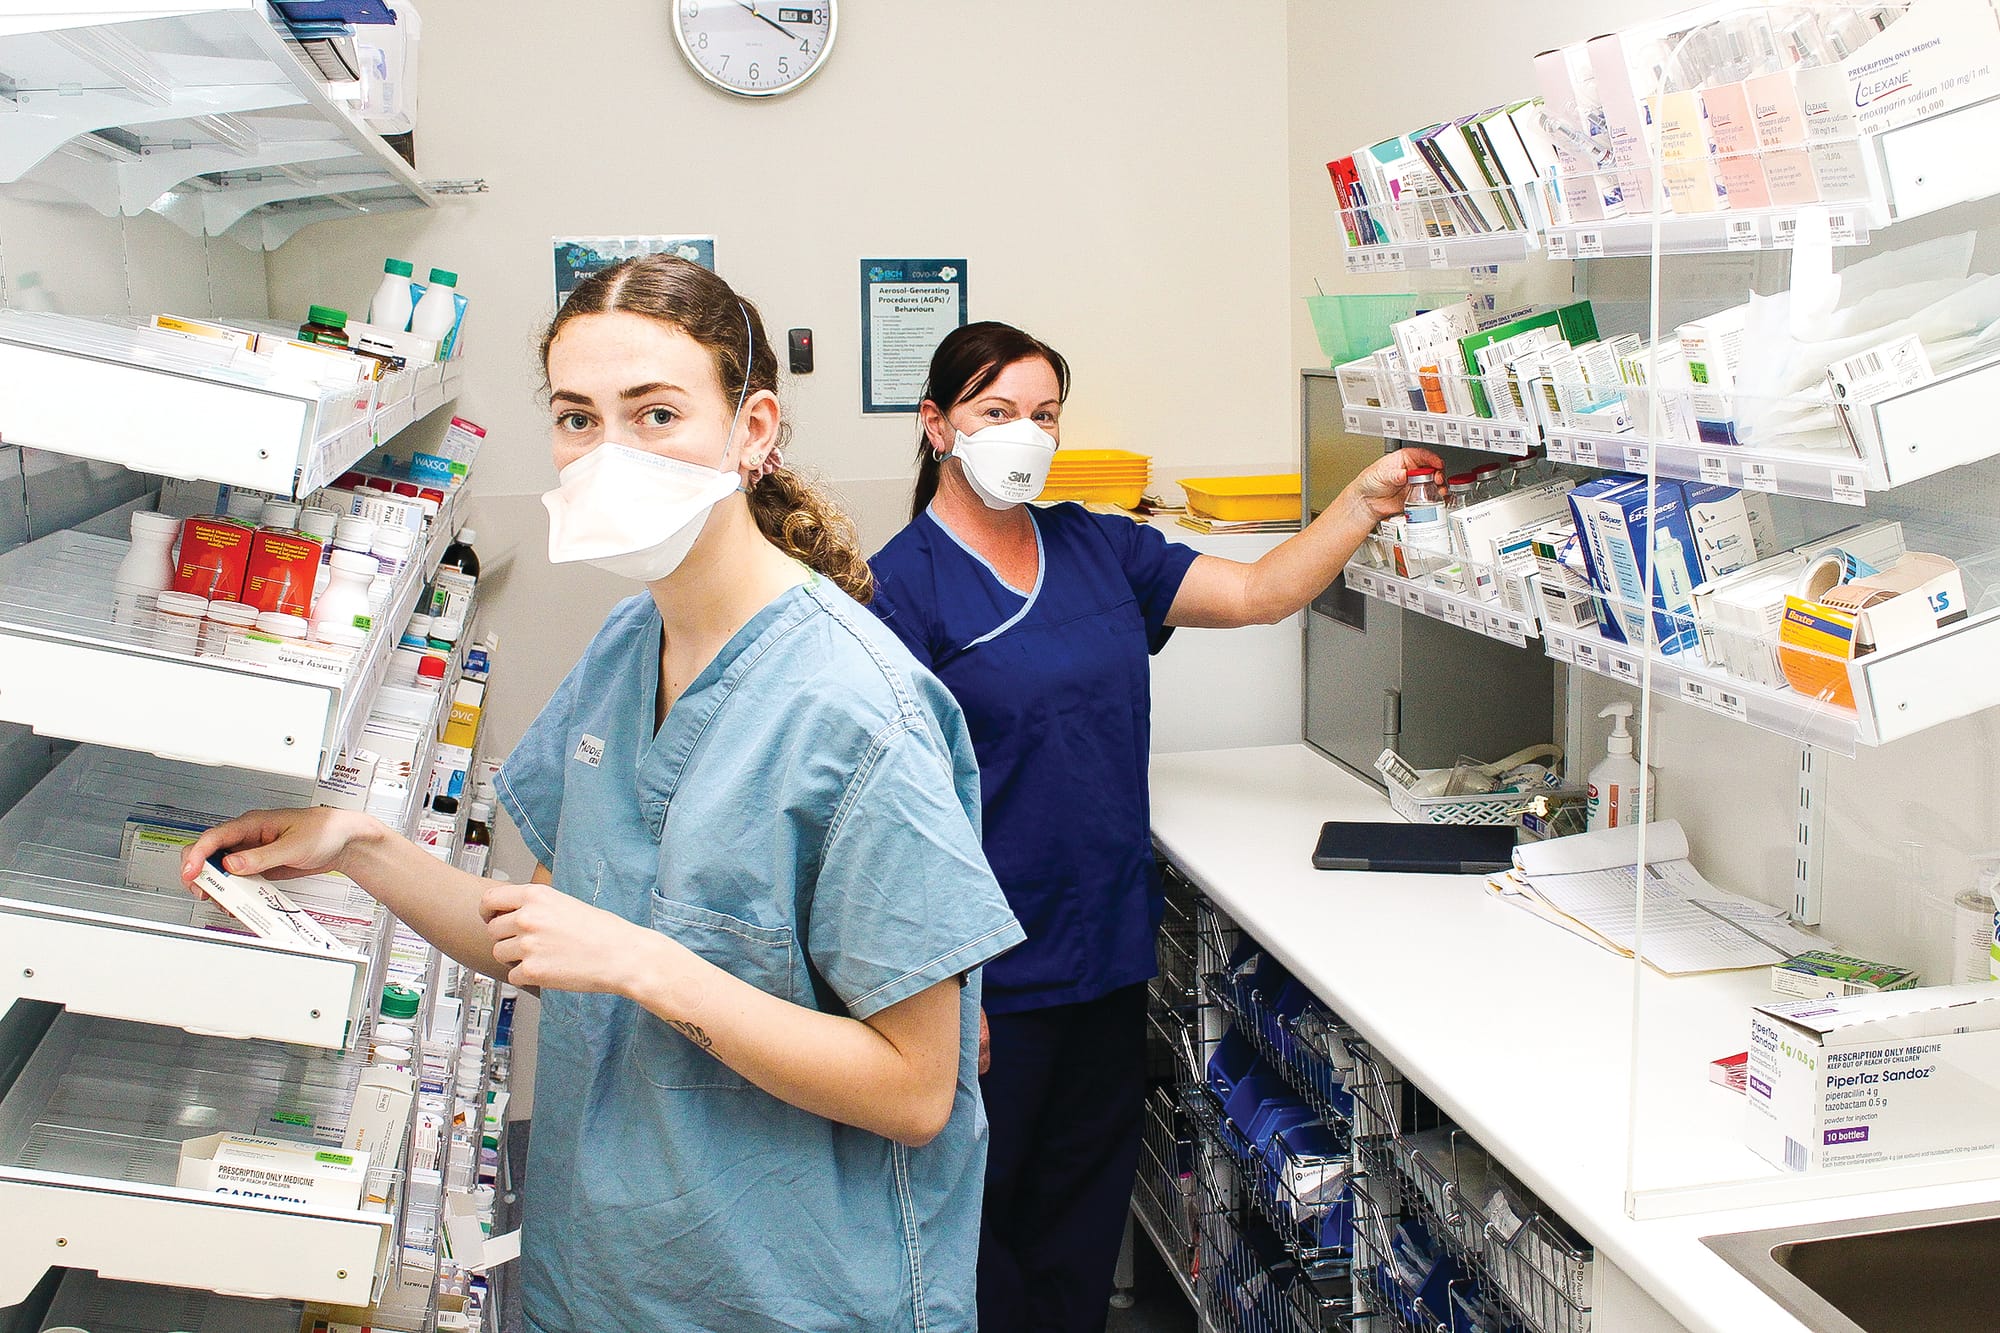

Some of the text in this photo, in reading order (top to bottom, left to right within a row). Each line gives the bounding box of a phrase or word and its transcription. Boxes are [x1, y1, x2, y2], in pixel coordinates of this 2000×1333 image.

[688, 1, 698, 18] 9
[813, 9, 822, 25] 3
[698, 32, 708, 49] 8
[799, 39, 810, 55] 4
[720, 55, 729, 71] 7
[777, 57, 788, 74] 5
[1848, 54, 1894, 77] PRESCRIPTION
[1895, 48, 1911, 61] ONLY
[1911, 37, 1941, 53] MEDICINE
[749, 63, 759, 80] 6
[1859, 98, 1906, 122] enoxaparin
[1907, 85, 1937, 104] sodium
[1940, 78, 1955, 93] 100
[1917, 99, 1944, 116] 10,000
[1008, 472, 1031, 483] 3M
[1788, 610, 1815, 625] Baxter
[206, 876, 225, 893] arrow
[1752, 1019, 1778, 1041] PiperTaz
[1780, 1041, 1785, 1051] 4
[1786, 1046, 1791, 1057] g
[1792, 1048, 1796, 1058] /
[1797, 1050, 1808, 1064] 0.5
[1809, 1059, 1815, 1071] g
[1828, 1044, 1941, 1063] PRESCRIPTION ONLY MEDICINE
[1892, 1055, 1920, 1064] CHILDREN
[1827, 1073, 1879, 1089] PiperTaz
[1826, 1090, 1864, 1102] piperacillin
[1873, 1089, 1878, 1097] g
[1825, 1098, 1888, 1111] tazobactam 0.5 g
[1824, 1116, 1844, 1125] powder
[1855, 1113, 1878, 1122] injection
[1827, 1130, 1865, 1142] 10 bottles
[218, 1165, 314, 1187] PRESCRIPTION ONLY MEDICINE
